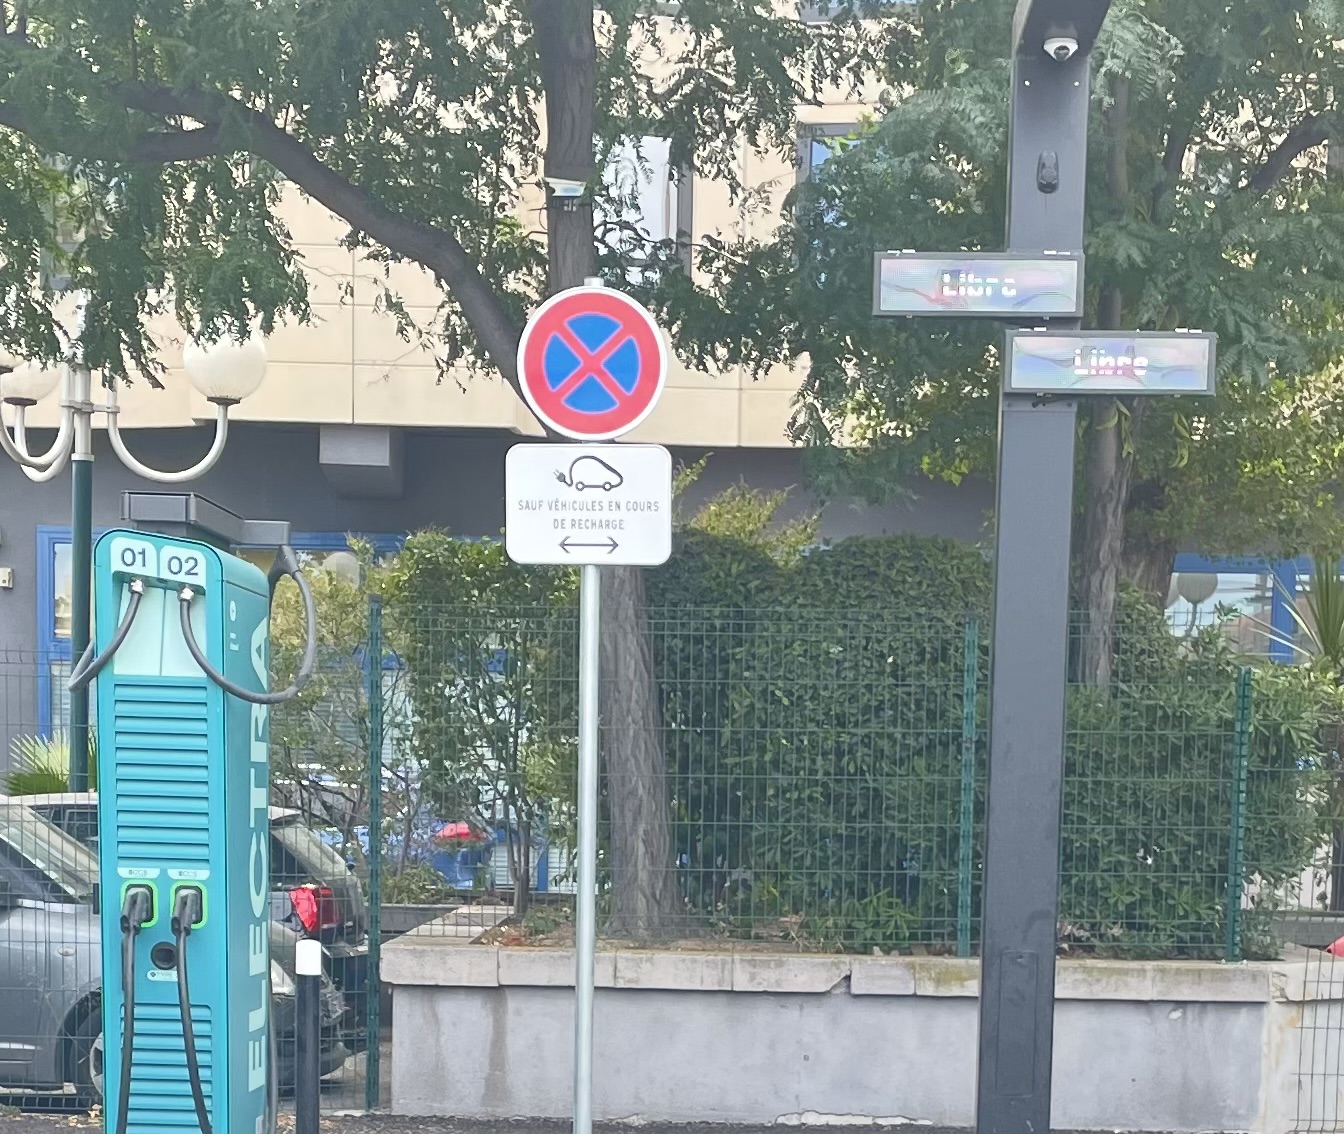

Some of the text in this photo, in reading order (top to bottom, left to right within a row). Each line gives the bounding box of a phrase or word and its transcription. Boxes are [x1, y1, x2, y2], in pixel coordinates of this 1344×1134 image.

[517, 498, 660, 512] SAUF VÉHICULES EN COURS
[553, 518, 625, 530] DE RECHARGE
[120, 547, 147, 568] 01
[167, 555, 199, 576] 02
[248, 617, 268, 1092] ELECTRA
